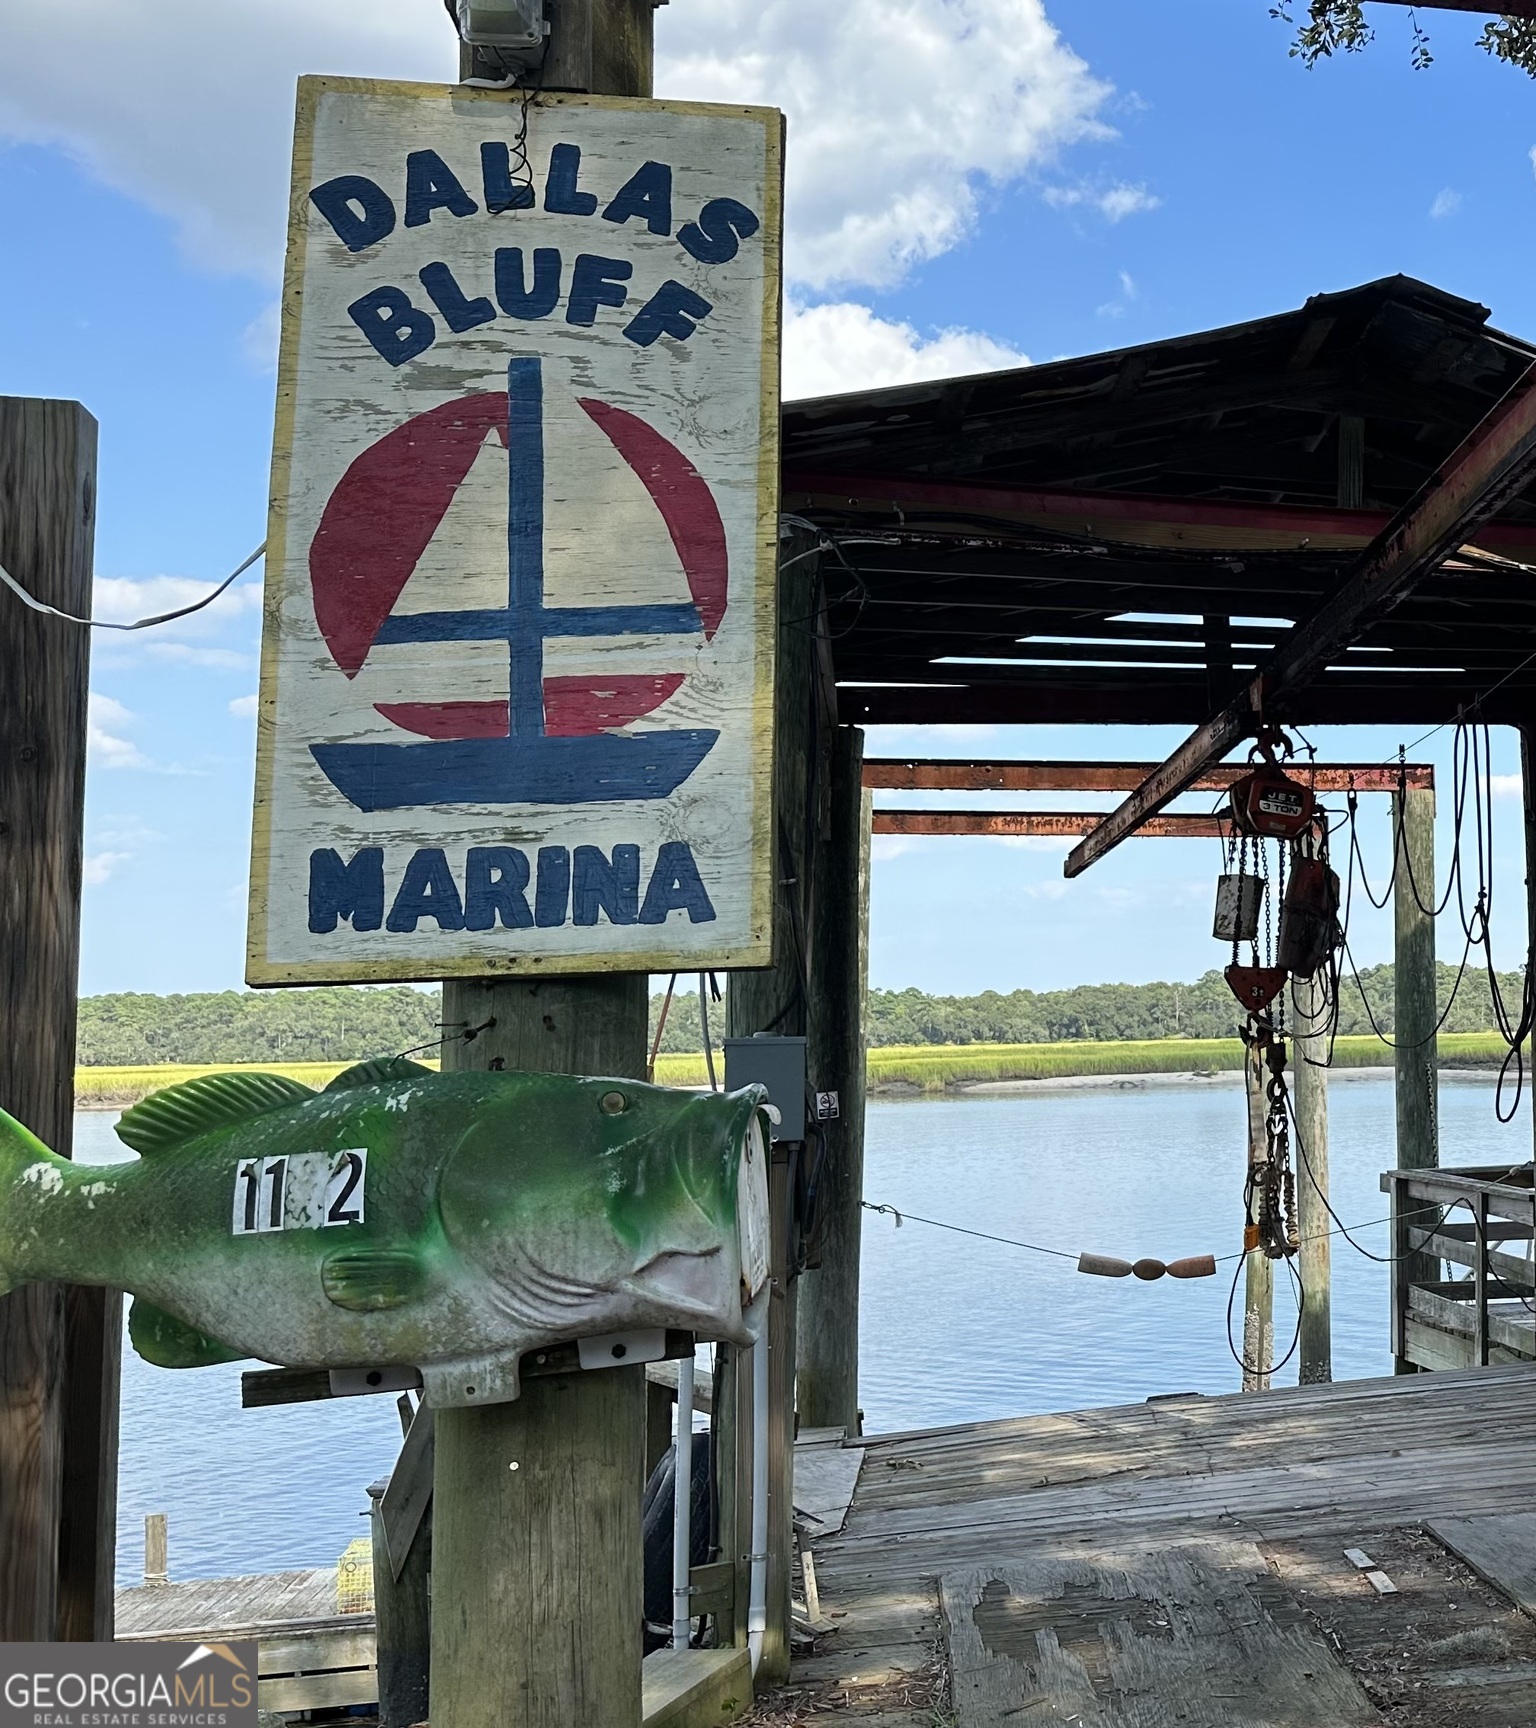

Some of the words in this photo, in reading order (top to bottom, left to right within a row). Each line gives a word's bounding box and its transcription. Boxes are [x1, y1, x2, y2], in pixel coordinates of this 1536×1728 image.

[308, 142, 760, 265] DALLAS
[347, 246, 713, 367] BLUFF
[1262, 802, 1271, 810] 3
[1274, 804, 1298, 814] TON
[1268, 792, 1297, 802] JET
[307, 841, 717, 934] MARINA
